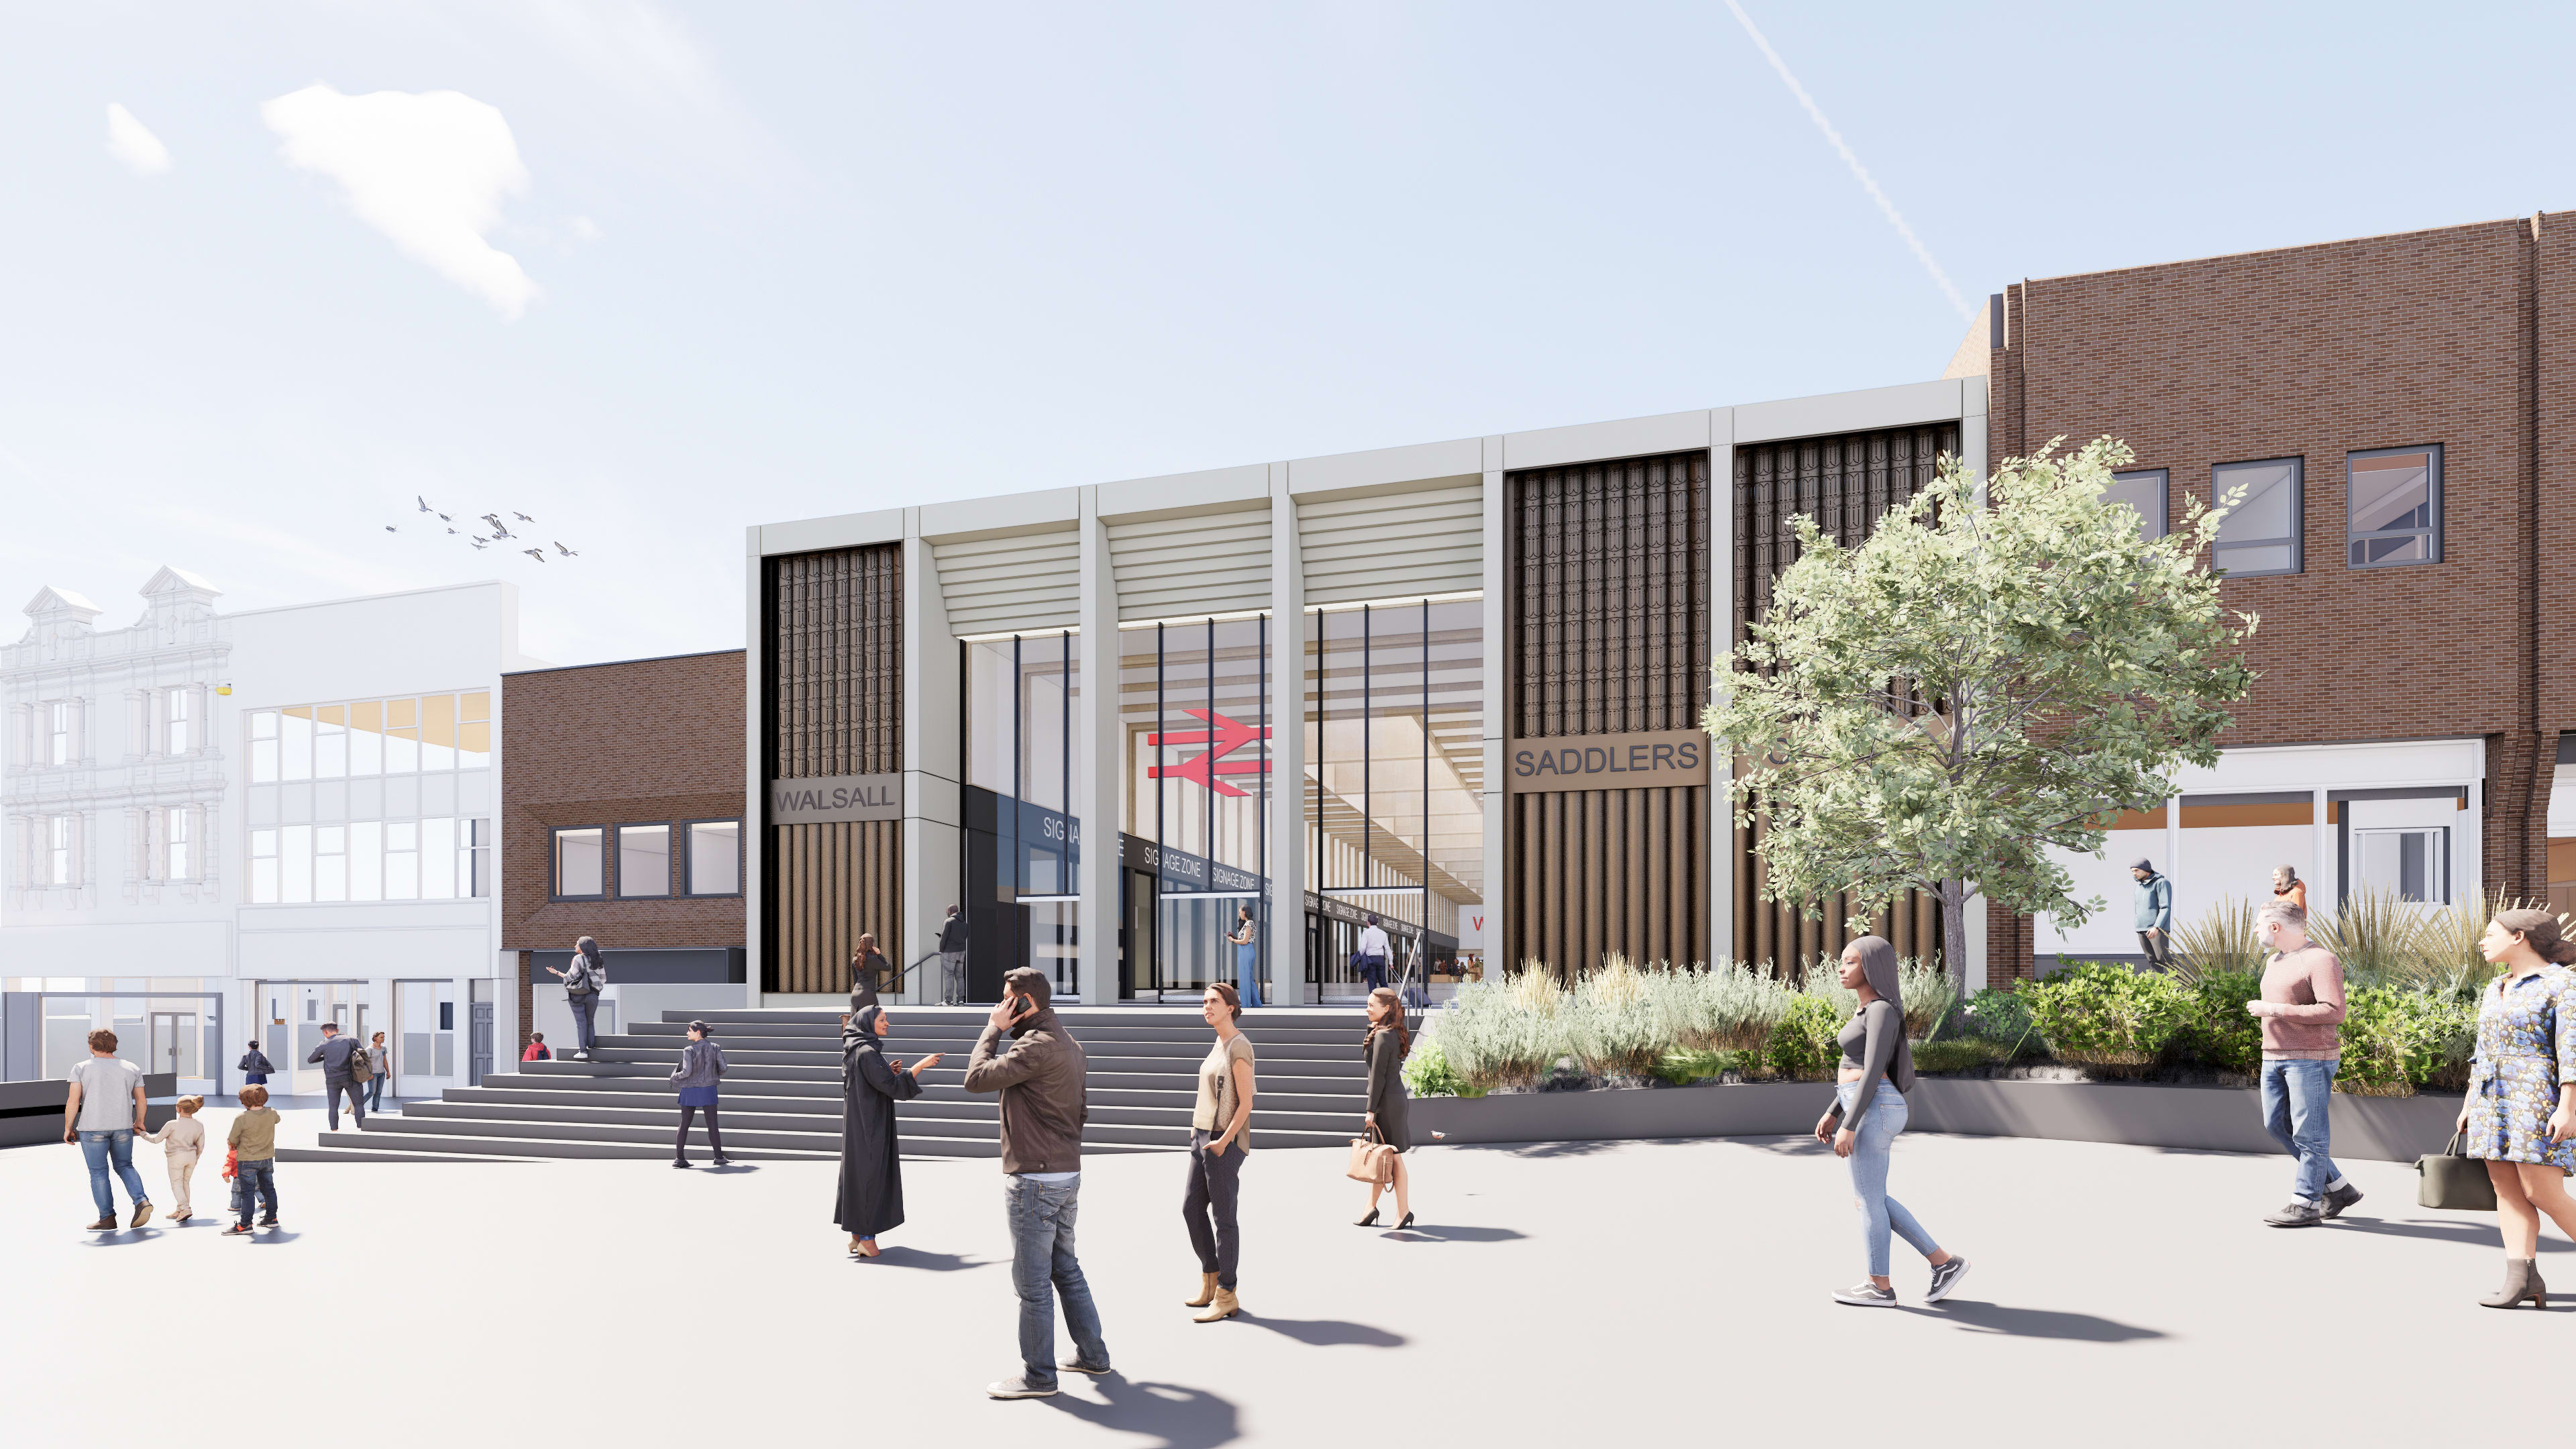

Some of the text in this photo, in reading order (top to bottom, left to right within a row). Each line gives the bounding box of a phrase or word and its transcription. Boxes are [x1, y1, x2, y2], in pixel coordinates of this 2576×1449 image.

[1515, 742, 1699, 777] SADDLERS
[776, 786, 896, 812] WALSALL
[1181, 857, 1201, 877] ZONE
[1213, 867, 1239, 888] SIGNAGE
[1305, 895, 1331, 912] SIGNAG ONE
